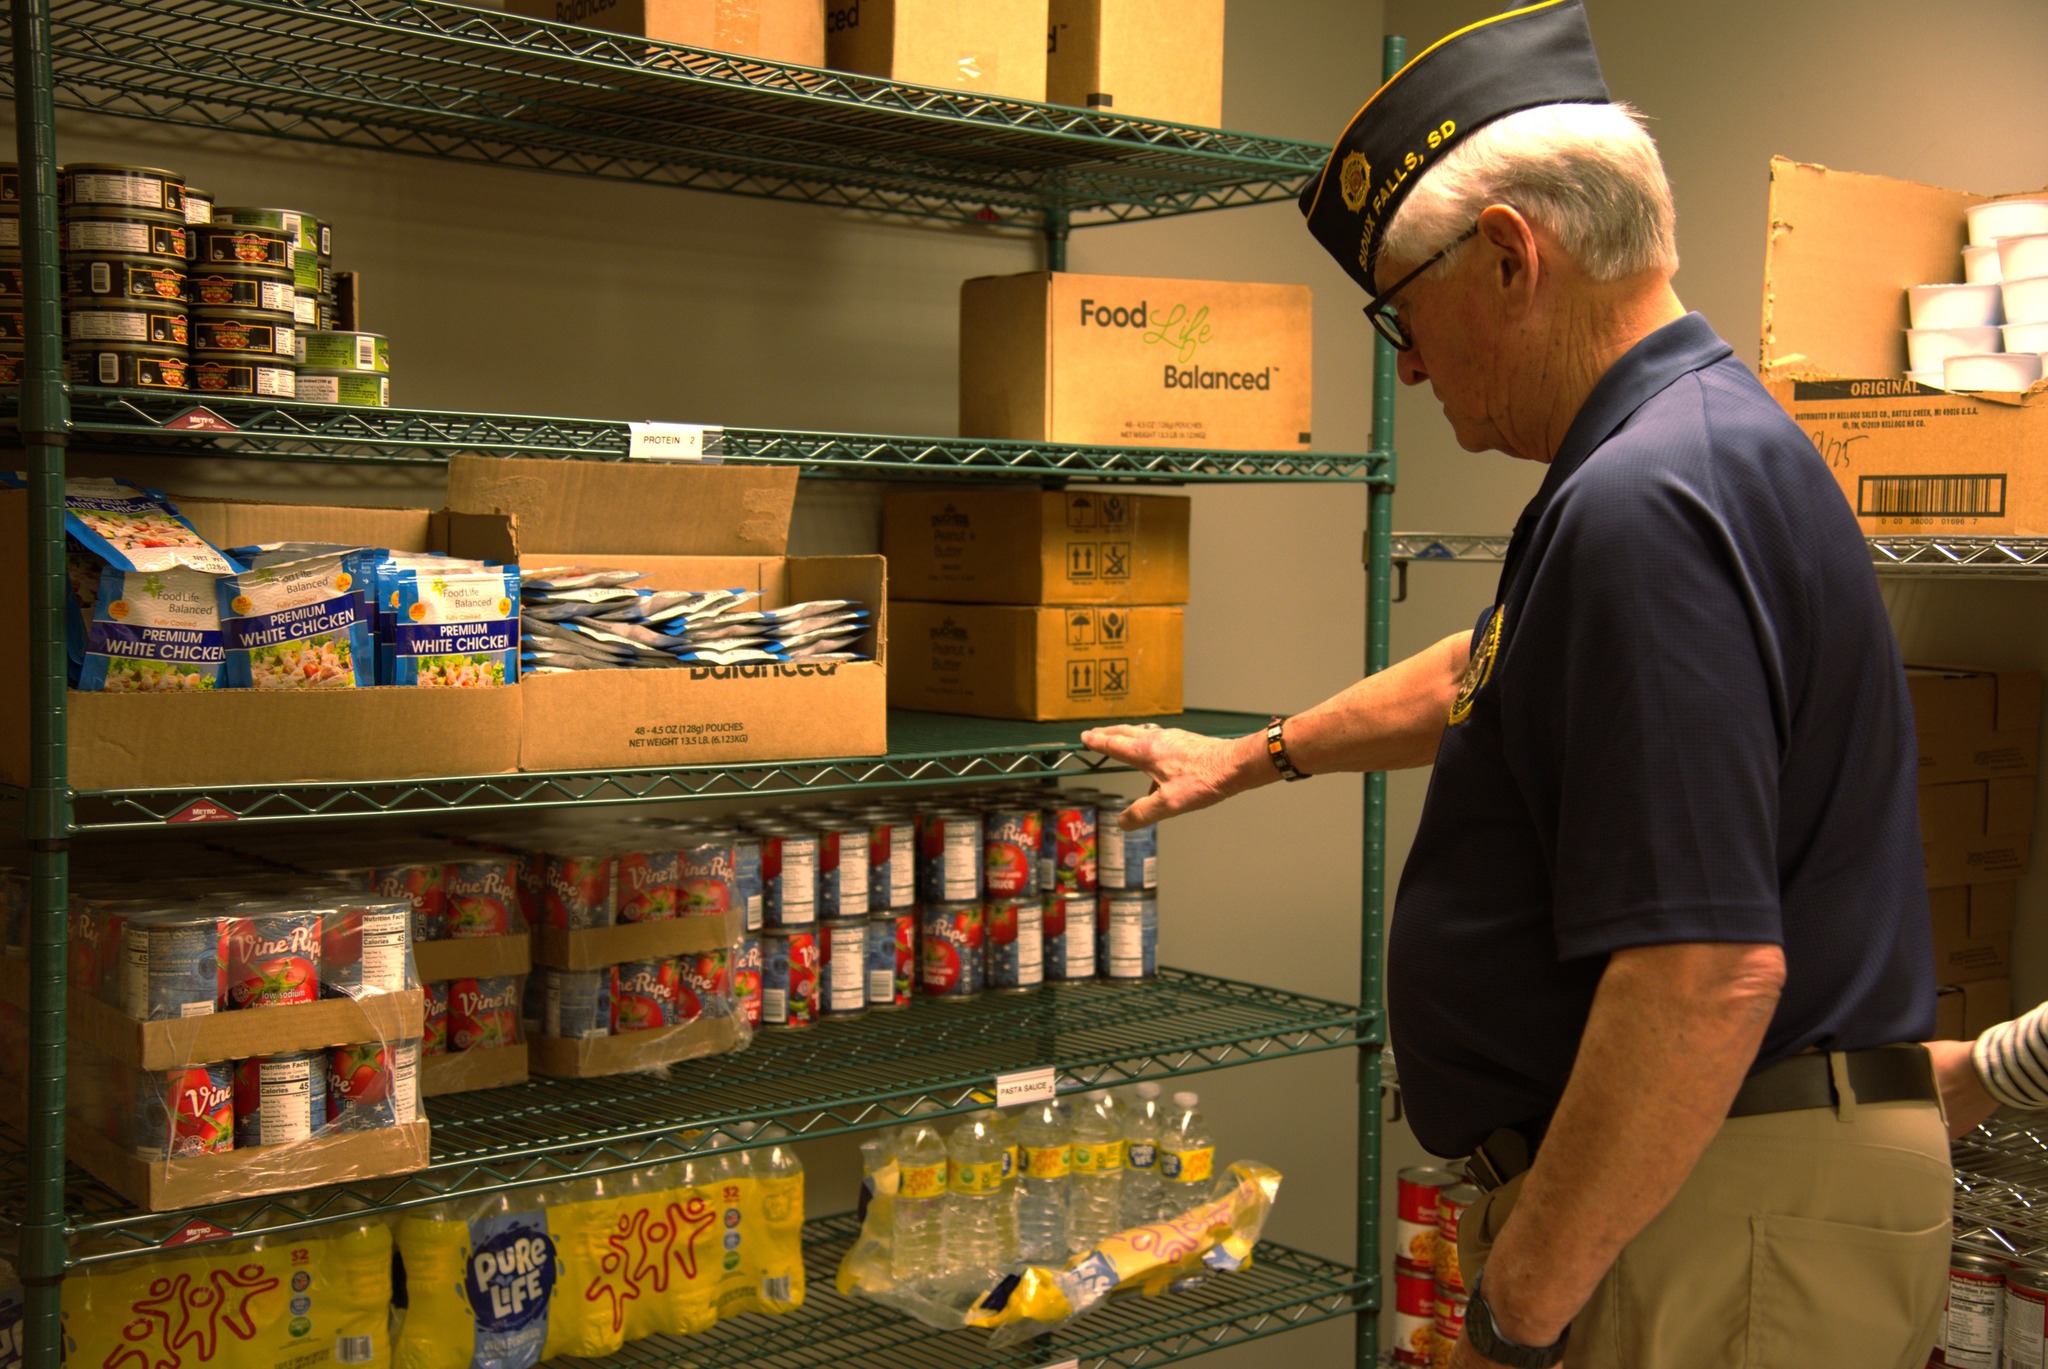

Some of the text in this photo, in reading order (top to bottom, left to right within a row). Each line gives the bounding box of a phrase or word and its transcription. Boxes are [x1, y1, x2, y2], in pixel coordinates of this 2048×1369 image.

[1359, 120, 1456, 273] SIOUX FALLS, SD
[1080, 299, 1213, 363] Food Life
[1851, 380, 1920, 396] ORIGINAL
[643, 436, 680, 444] PROTEIN
[287, 577, 328, 594] Balanced
[443, 588, 479, 598] Food Life
[157, 591, 199, 602] Food Life
[455, 598, 492, 608] Balanced
[169, 603, 213, 615] Balanced
[270, 604, 326, 626] PREMIUM
[239, 608, 354, 647] WHITE CHICKEN
[440, 623, 488, 637] PREMIUM
[143, 629, 203, 644] PREMIUM
[411, 635, 509, 653] WHITE CHICKEN
[106, 638, 155, 656] WHITE
[635, 727, 645, 735] 48
[651, 726, 663, 734] 4.5
[665, 726, 677, 734] OZ
[679, 724, 704, 734] (128g)
[705, 722, 743, 732] POUCHES
[629, 734, 748, 747] NET WEIGHT 13.5 LB. (6.123KG)
[1003, 823, 1034, 846] Ripe
[545, 866, 578, 896] Ripe
[628, 866, 668, 890] Vine
[934, 918, 968, 943] Ripe
[236, 934, 289, 963] Vine
[279, 989, 305, 998] sodium
[635, 972, 671, 999] Ripe
[459, 992, 503, 1017] Vine
[299, 1082, 309, 1090] 45
[327, 1064, 351, 1093] ipe
[1001, 1086, 1022, 1095] PASTA
[1024, 1082, 1047, 1092] SAUCE
[185, 1086, 232, 1118] Vine
[186, 1227, 211, 1236] METRO
